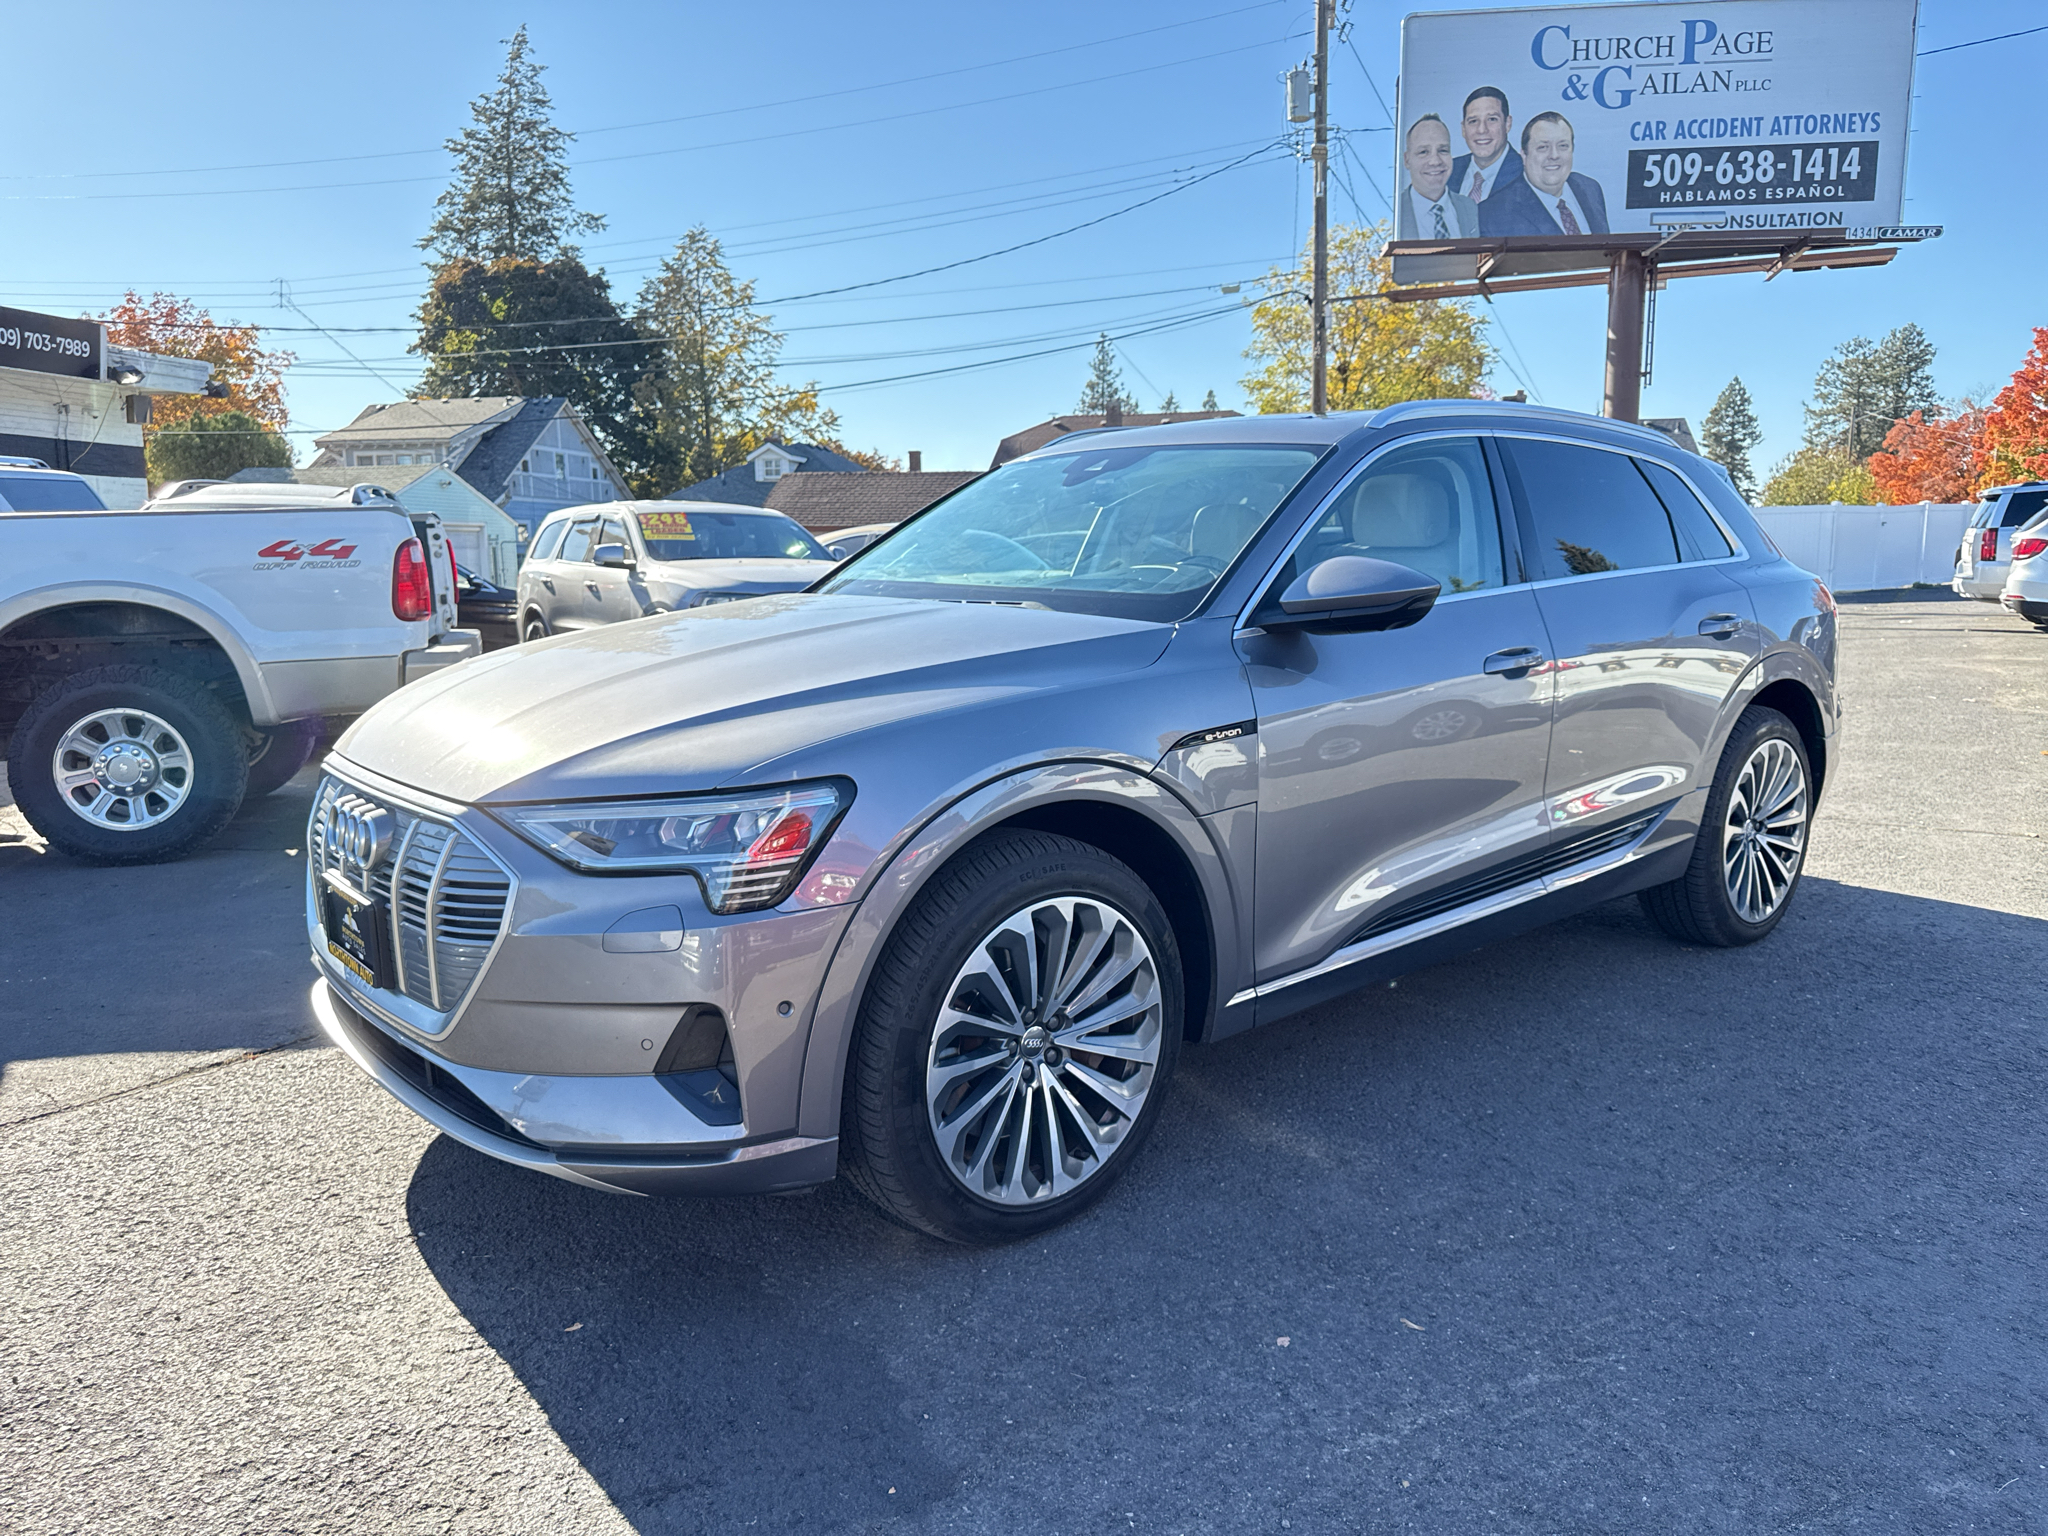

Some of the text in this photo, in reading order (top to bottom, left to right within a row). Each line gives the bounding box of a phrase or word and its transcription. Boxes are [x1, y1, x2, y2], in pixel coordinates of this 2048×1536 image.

[1735, 79, 1772, 92] PLLC
[1630, 112, 1881, 141] CAR ACCIDENT ATTORNEYS
[1643, 147, 1861, 188] 509-638-1414
[1660, 184, 1845, 203] HABLAMOS ESPAÑOL
[1885, 228, 1937, 237] LAMAR
[24, 331, 91, 358] 703-7989
[253, 560, 361, 571] OFF ROAD
[1205, 728, 1242, 741] e-tron
[359, 966, 374, 987] AUTO
